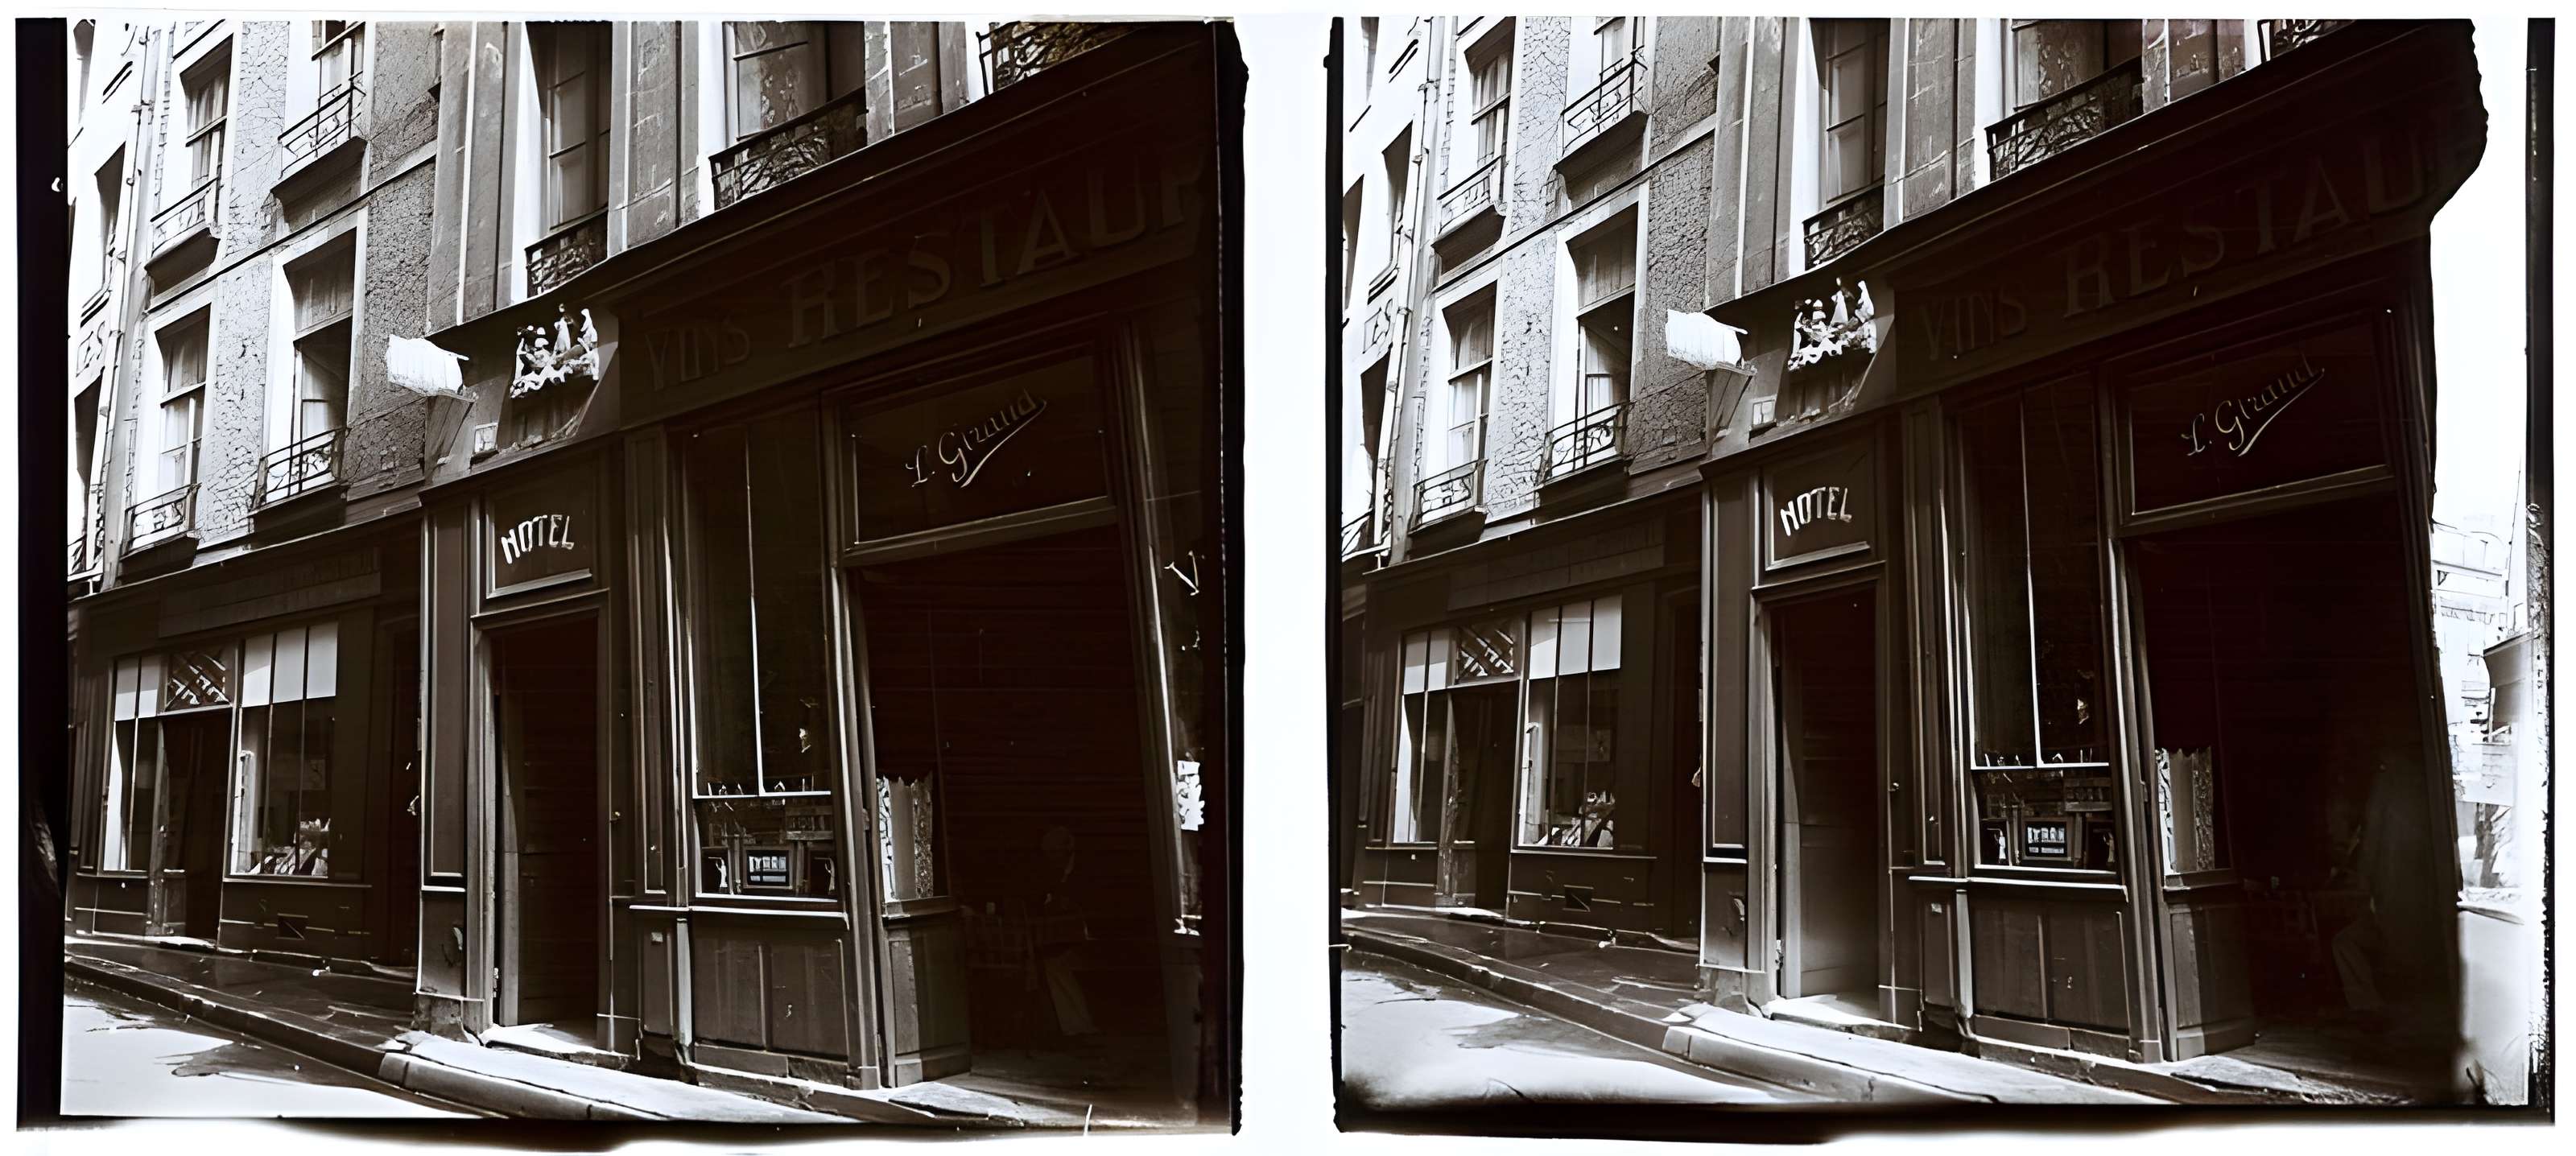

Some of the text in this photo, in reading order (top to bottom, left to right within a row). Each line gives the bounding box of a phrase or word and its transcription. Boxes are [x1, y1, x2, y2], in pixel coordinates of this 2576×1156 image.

[643, 315, 753, 393] VINS
[1919, 285, 2027, 361] VINS
[501, 514, 575, 564] HOTEL
[1780, 486, 1853, 537] HOTEL
